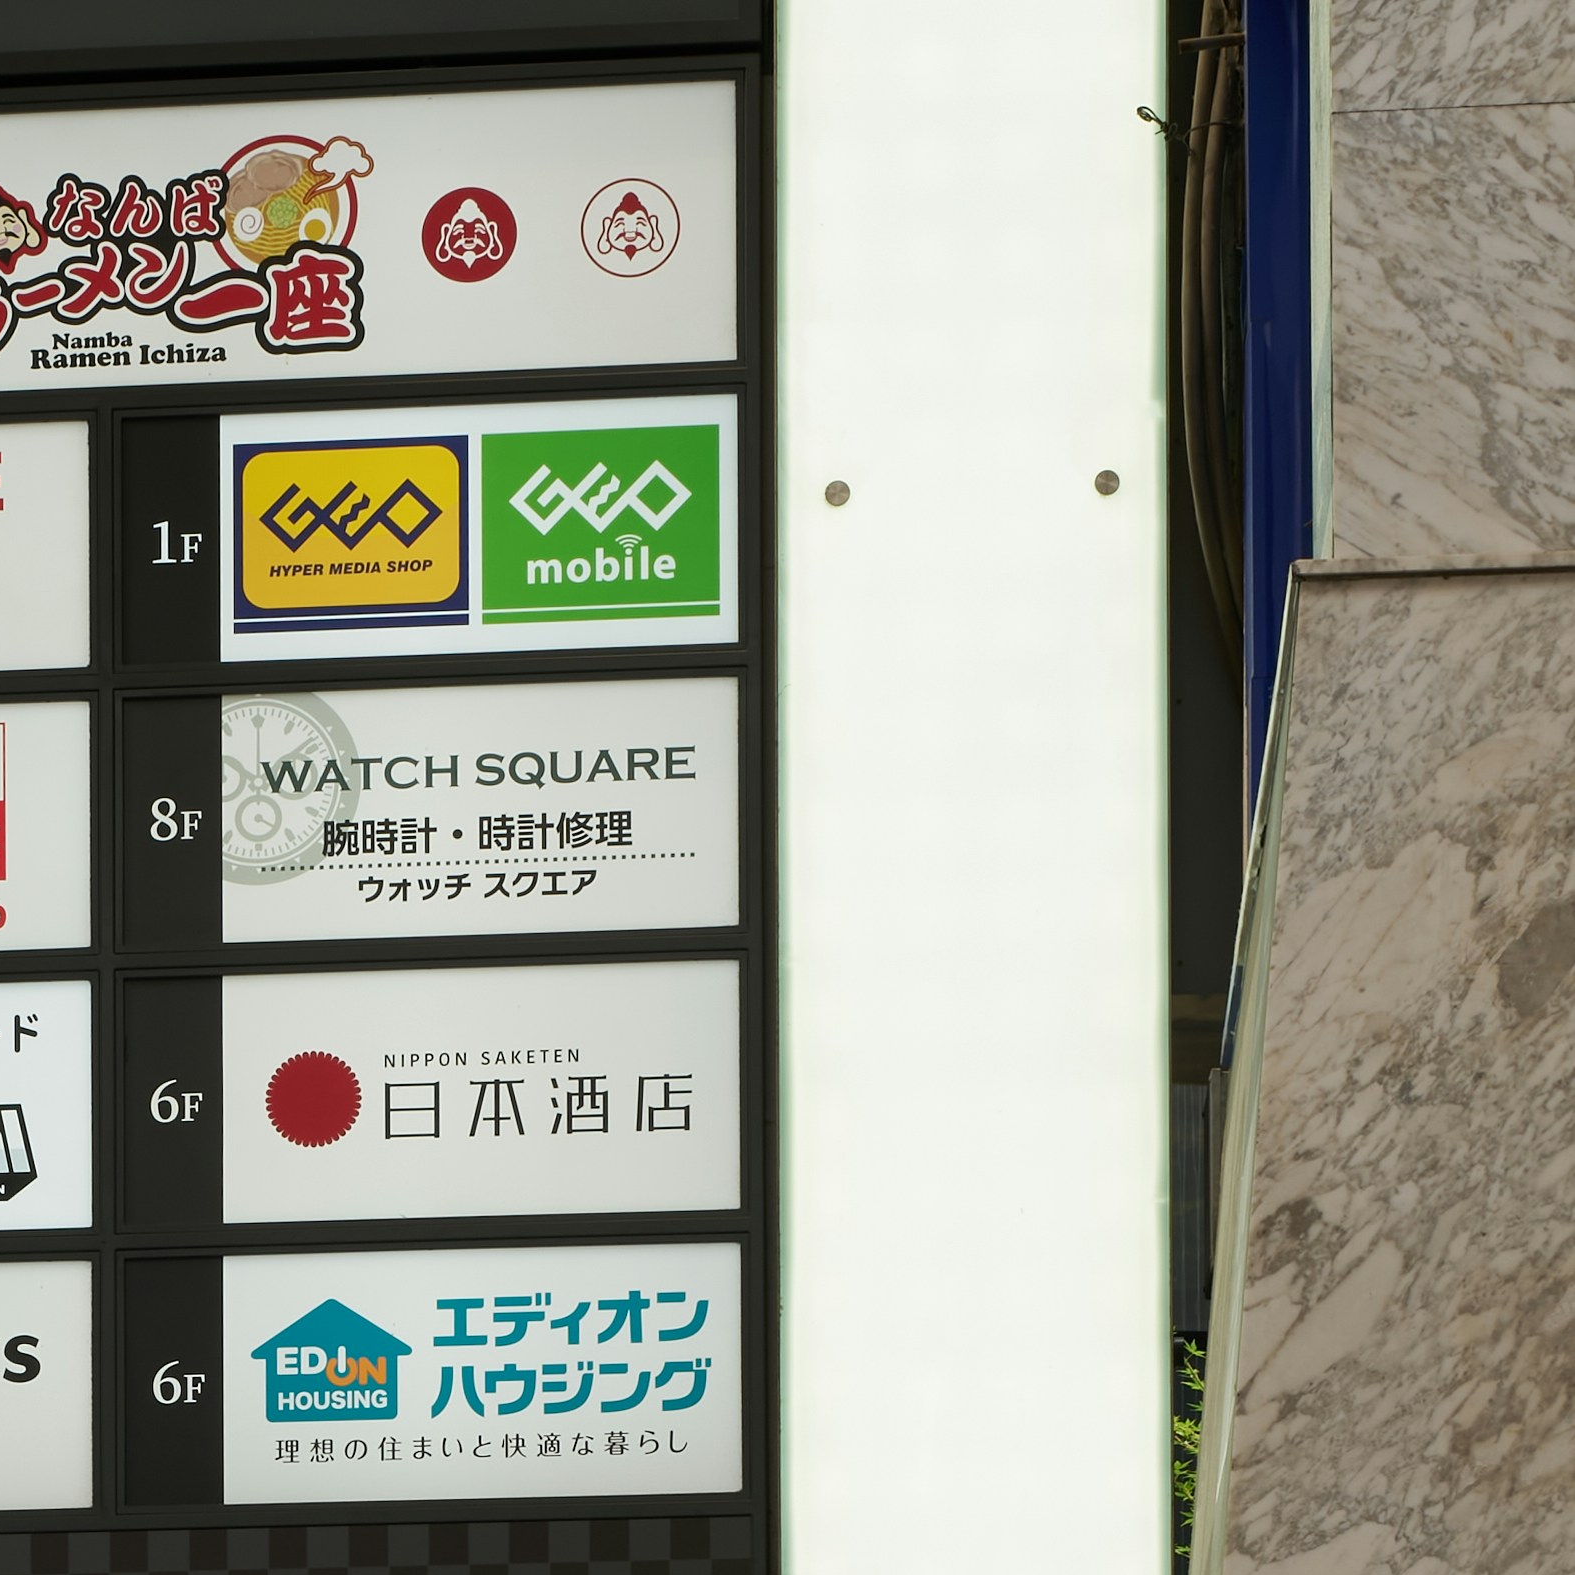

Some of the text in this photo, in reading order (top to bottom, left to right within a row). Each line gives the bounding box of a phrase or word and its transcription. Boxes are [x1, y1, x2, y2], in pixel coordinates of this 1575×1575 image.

[48, 172, 225, 242] なんば
[30, 343, 226, 369] Ramen Ichiza
[52, 333, 132, 349] Namba
[259, 478, 443, 552] GEO
[508, 459, 692, 535] GEO
[151, 521, 202, 564] 1F
[269, 558, 433, 577] HYPER MEDIA SHOP
[527, 545, 676, 585] mobile
[261, 746, 697, 794] WATCH SQUARE
[150, 798, 202, 841] 8F
[321, 811, 633, 857] 腕時計・時計修理
[358, 869, 598, 903] ウォッチ スクエア
[384, 1048, 581, 1068] NIPPON SAKETEN
[150, 1079, 203, 1123] 6F
[383, 1073, 693, 1139] 日本酒店
[433, 1290, 709, 1347] エディオン
[152, 1360, 205, 1405] 6F
[277, 1389, 388, 1412] HOUSING
[431, 1358, 712, 1418] ハウジング
[275, 1429, 688, 1464] 理想の住まいと快適な暮らし
